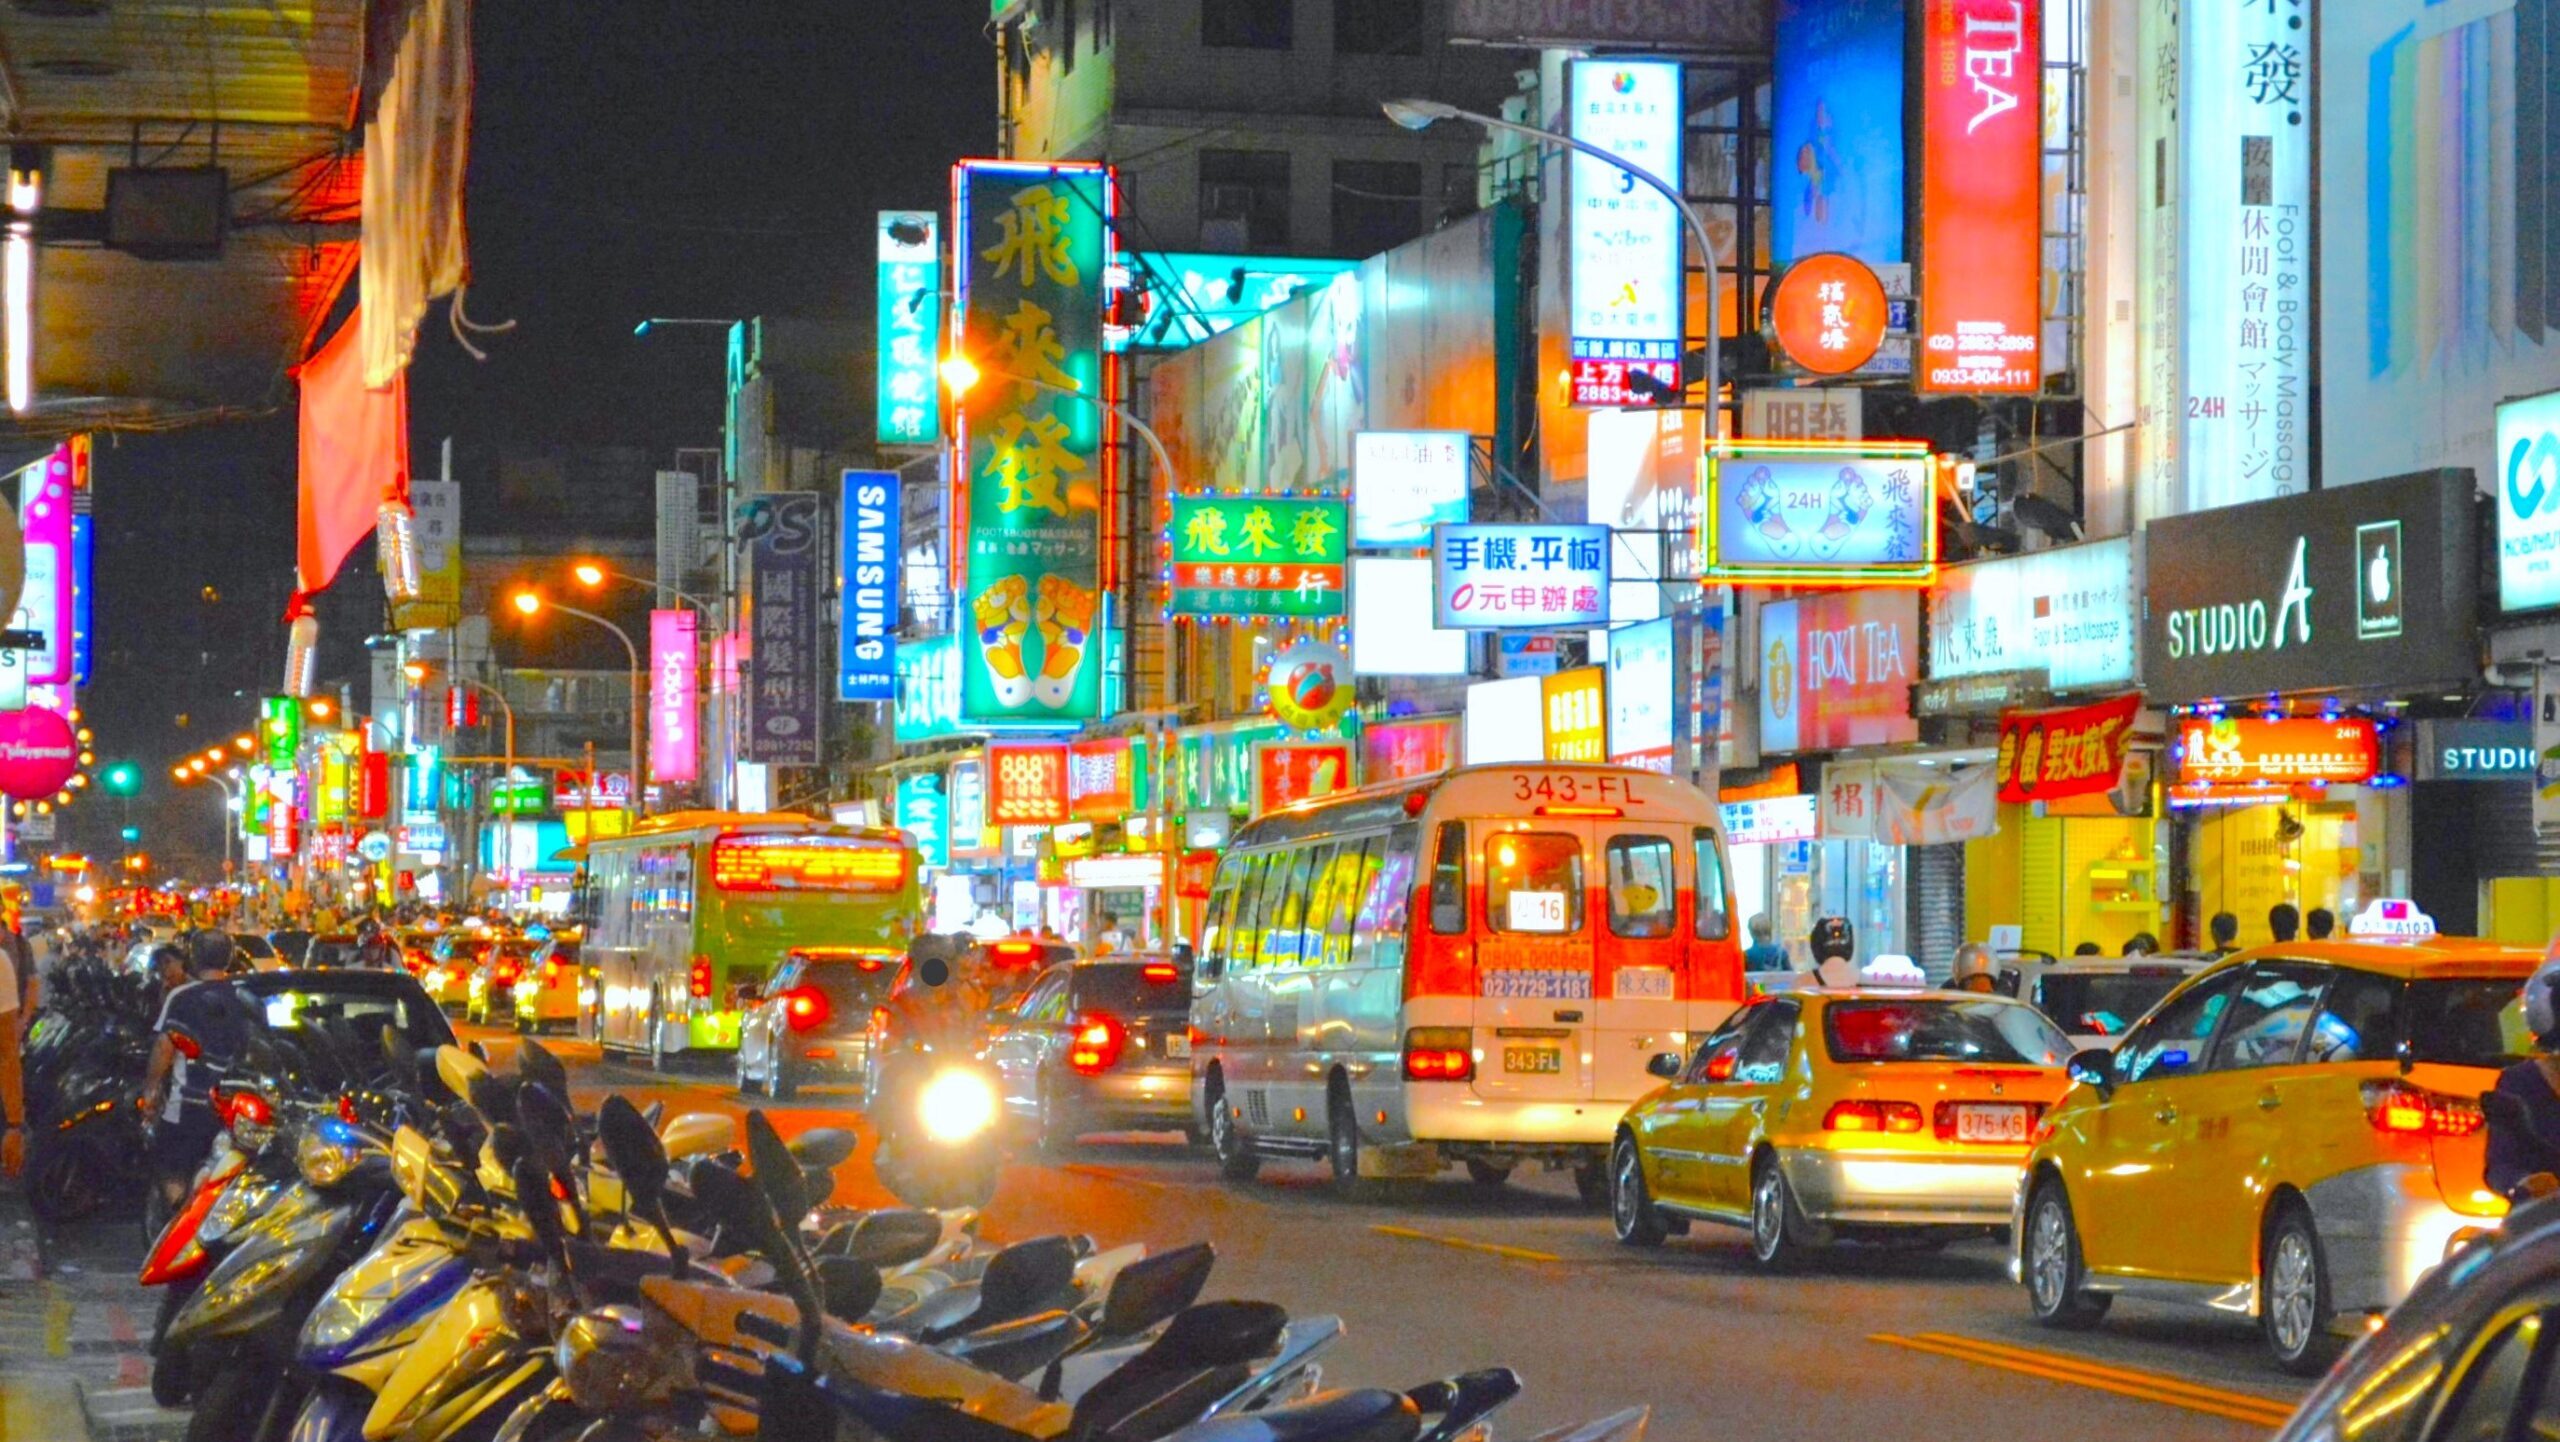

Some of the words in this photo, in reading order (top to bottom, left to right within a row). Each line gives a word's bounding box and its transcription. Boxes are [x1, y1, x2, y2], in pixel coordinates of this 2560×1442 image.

[1966, 1, 2022, 135] TEA
[2278, 205, 2299, 265] Foot
[2277, 271, 2298, 291] &
[981, 184, 1087, 516] 飛來發
[2273, 301, 2298, 367] Body
[2188, 396, 2225, 418] 24H
[2272, 376, 2298, 497] Massage
[1788, 492, 1821, 509] 24H
[1882, 468, 1912, 560] 飛來發
[1184, 505, 1337, 557] 飛來發
[855, 485, 887, 661] SAMSUNG
[1294, 571, 1329, 604] 行
[2168, 600, 2267, 659] STUDIO
[2274, 536, 2313, 650] A
[1808, 624, 1857, 690] HOKI
[1864, 621, 1905, 685] TEA
[2336, 727, 2360, 740] 24H
[1513, 774, 1645, 804] 343-FL
[2396, 922, 2431, 935] A103
[1506, 1051, 1558, 1071] 343-FL
[1962, 1114, 2023, 1137] 375-K6
